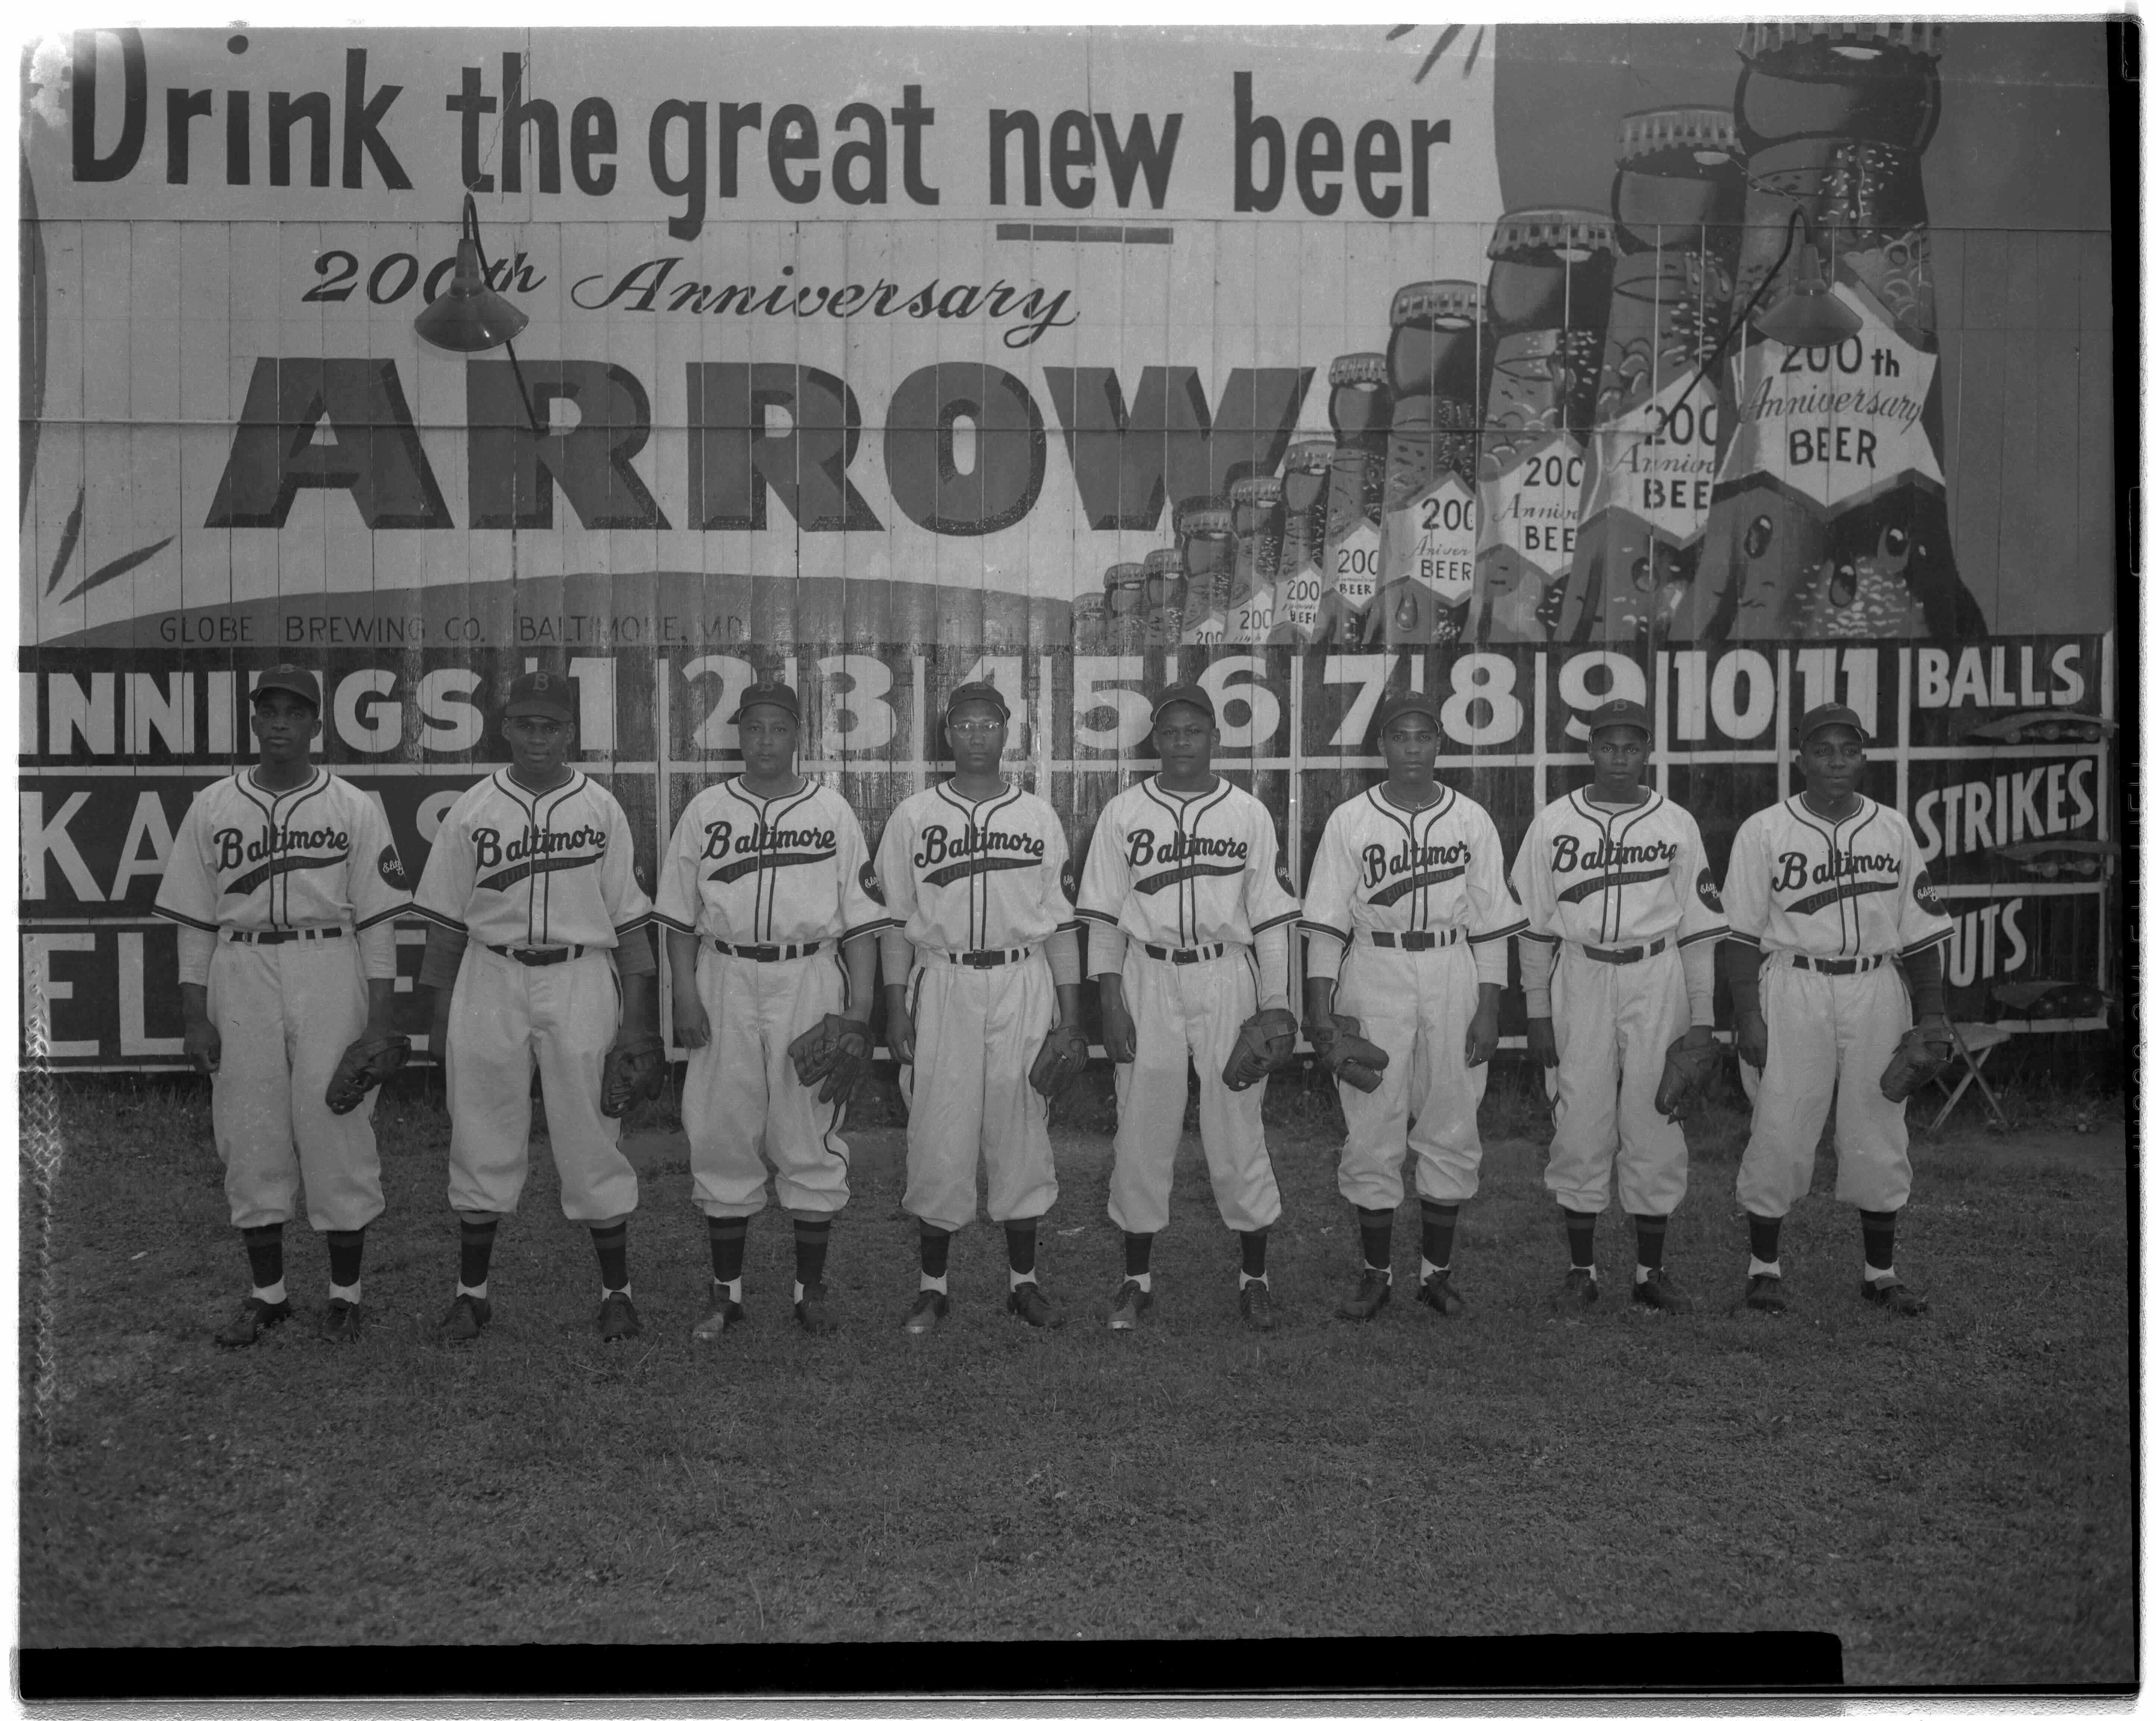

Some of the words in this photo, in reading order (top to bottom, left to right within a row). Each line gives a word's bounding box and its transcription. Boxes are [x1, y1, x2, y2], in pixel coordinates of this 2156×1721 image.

[72, 27, 414, 190] Drink
[446, 52, 617, 195] the
[649, 84, 940, 241] great
[989, 108, 1183, 209] new
[1233, 71, 1451, 219] beer
[570, 257, 1080, 349] Anniversary
[1780, 335, 1863, 374] 200
[1871, 349, 1900, 377] th
[1738, 375, 1922, 435] Anniversary
[203, 357, 1317, 536] ARROW
[1790, 427, 1876, 468] BEER
[1287, 580, 1320, 601] 200
[1339, 583, 1371, 595] BEER
[1421, 559, 1472, 581] BEER
[160, 616, 254, 643] GLOBE
[285, 616, 425, 643] BREWING
[444, 617, 485, 643] CO.
[533, 672, 550, 691] B
[1918, 644, 2085, 708] BALLS
[567, 657, 617, 750] 1
[682, 655, 758, 749] 2
[816, 654, 897, 751] 3
[1073, 655, 1154, 749] 5
[1196, 655, 1281, 748] 6
[1323, 654, 1400, 746] 7
[1440, 652, 1525, 746] 8
[1558, 650, 1646, 741] 9
[1673, 649, 1776, 741] 10
[1796, 647, 1879, 739] 11
[1915, 759, 2094, 864] STRIKES
[213, 824, 349, 874] Baltimore
[472, 824, 606, 871] Baltimore
[701, 820, 837, 860] Baltimore
[914, 822, 1045, 868] Baltimore
[1127, 828, 1248, 867] Baltimore
[1417, 869, 1454, 885] GIANTS
[1574, 876, 1604, 899] ELITE
[1609, 873, 1651, 885] GIANTS
[1941, 898, 2027, 988] UTS
